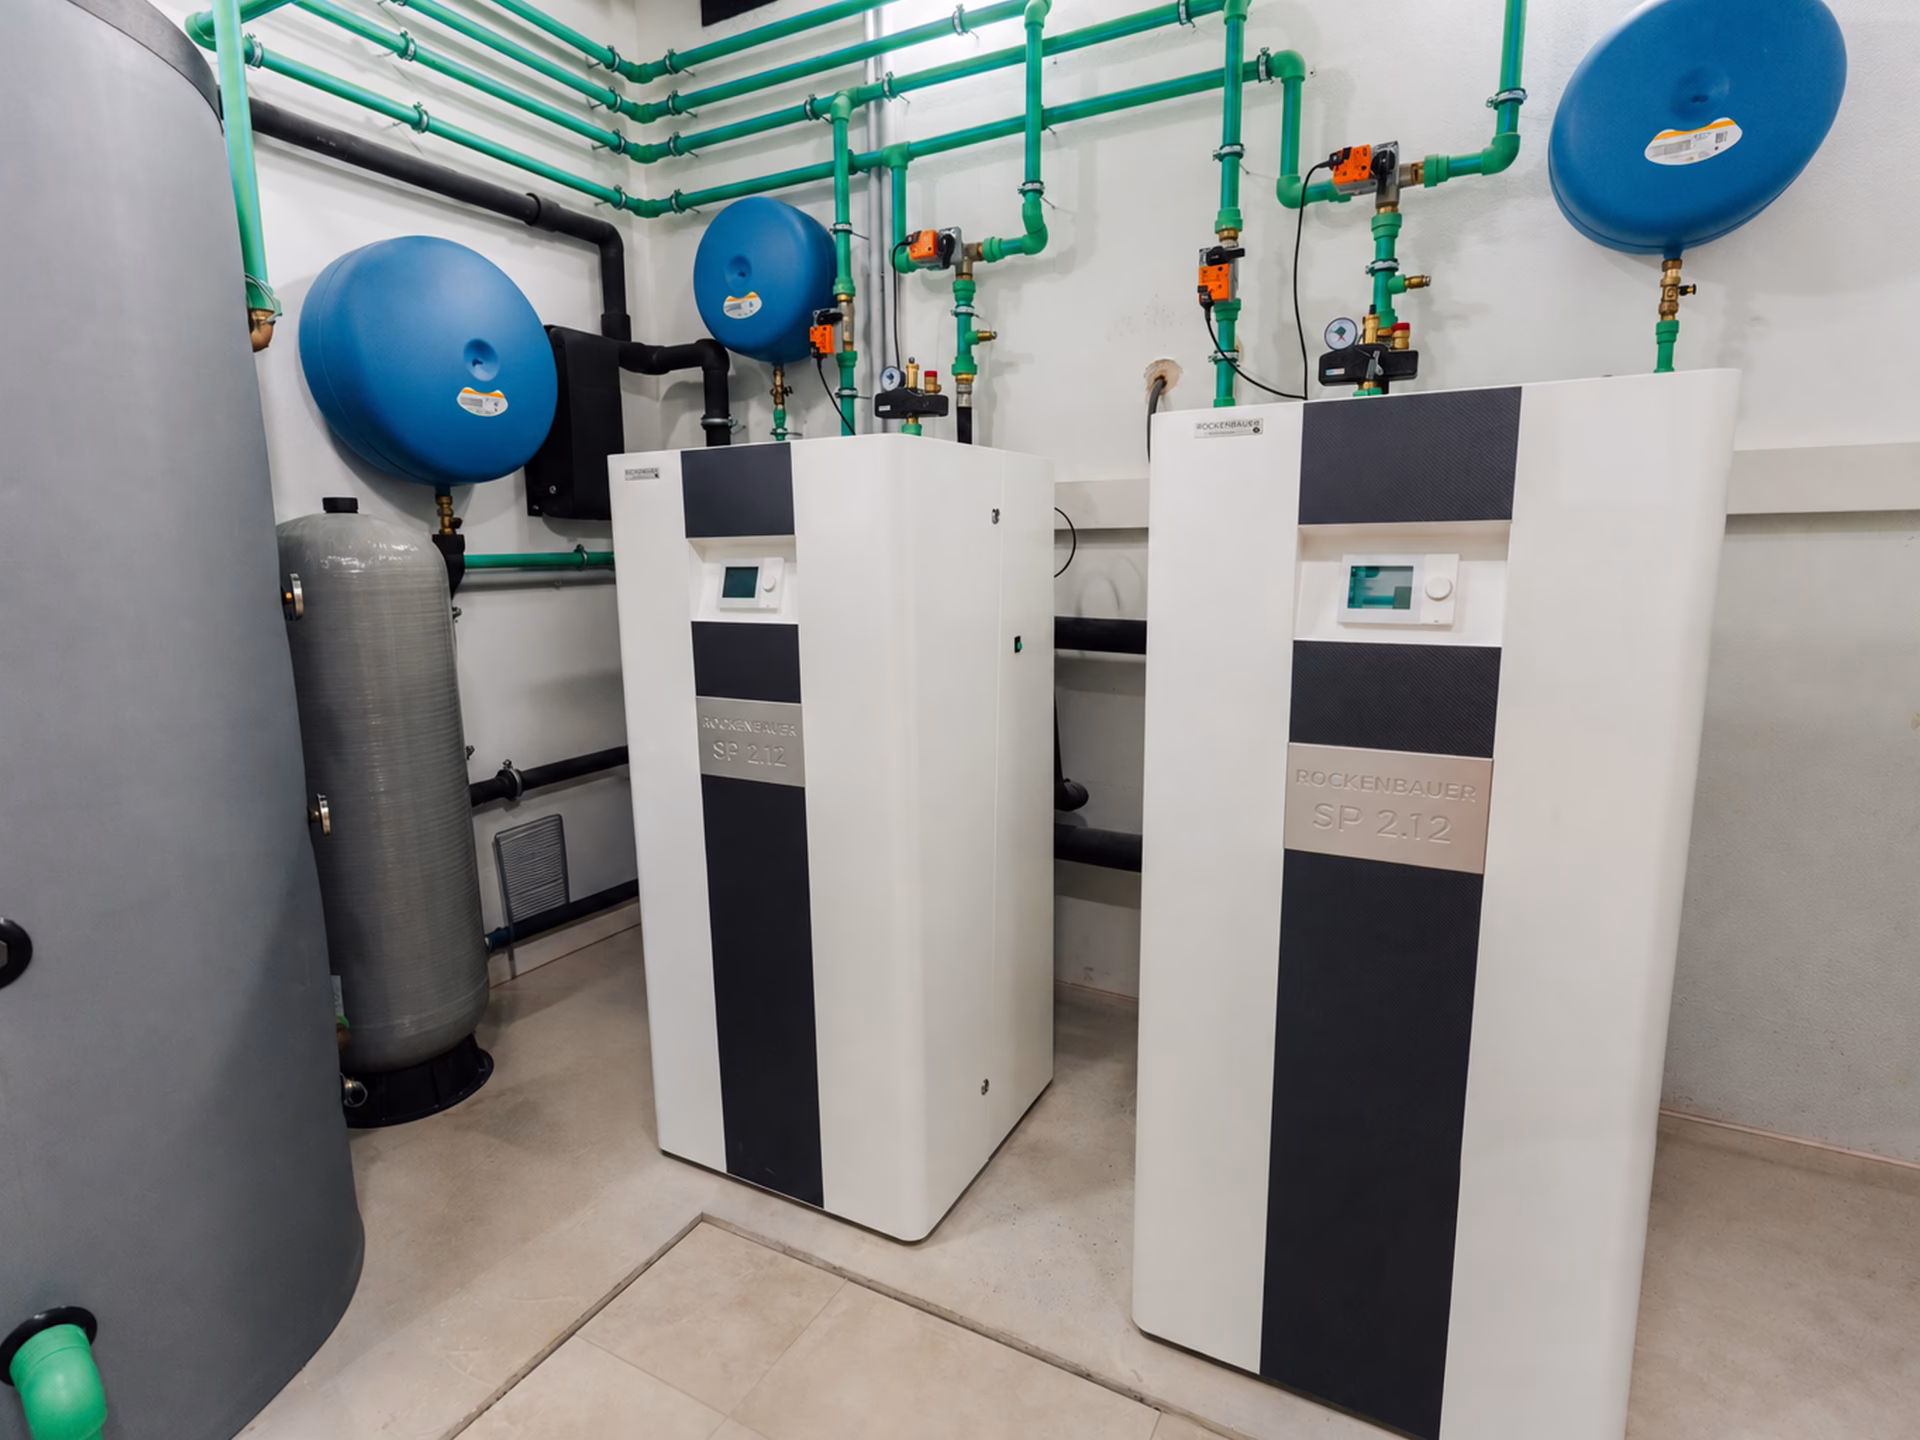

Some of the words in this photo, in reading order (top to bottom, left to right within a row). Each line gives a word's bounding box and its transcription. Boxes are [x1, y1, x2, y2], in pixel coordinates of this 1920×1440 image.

[703, 716, 797, 737] ROCKENBAUER
[713, 741, 738, 761] SP
[747, 744, 787, 768] 2.12
[1295, 769, 1476, 802] ROCKENBAUER
[1313, 802, 1363, 832] SP
[1376, 809, 1452, 844] 2.12
